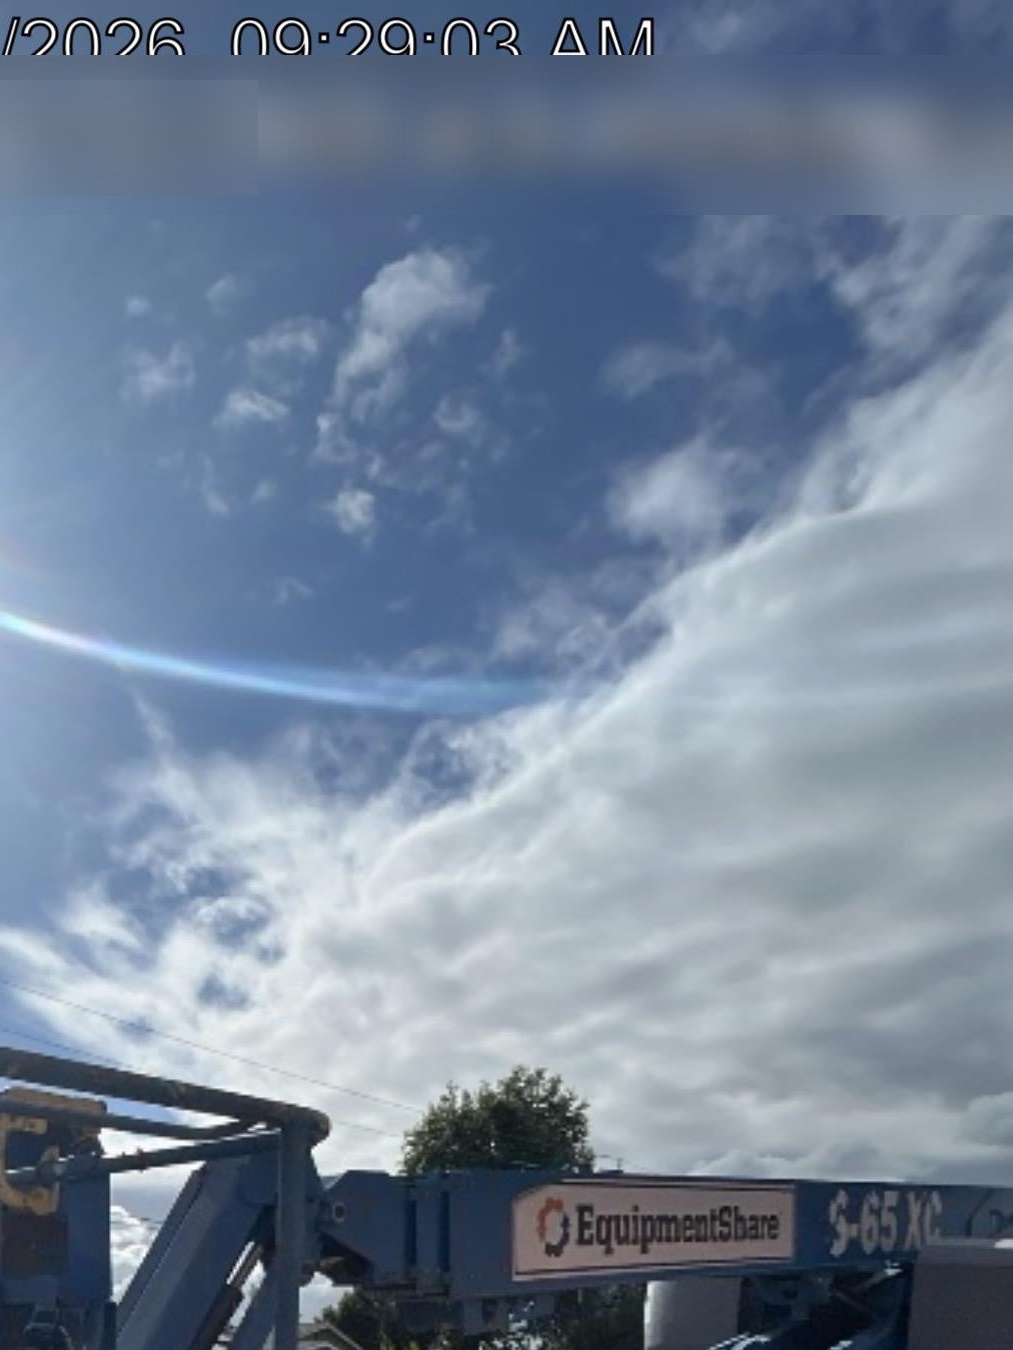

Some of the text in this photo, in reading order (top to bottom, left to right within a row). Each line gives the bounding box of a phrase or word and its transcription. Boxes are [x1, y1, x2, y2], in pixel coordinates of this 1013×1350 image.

[575, 1204, 780, 1255] EquipmentShare
[829, 1189, 899, 1257] S-65
[903, 1189, 943, 1250] XC
